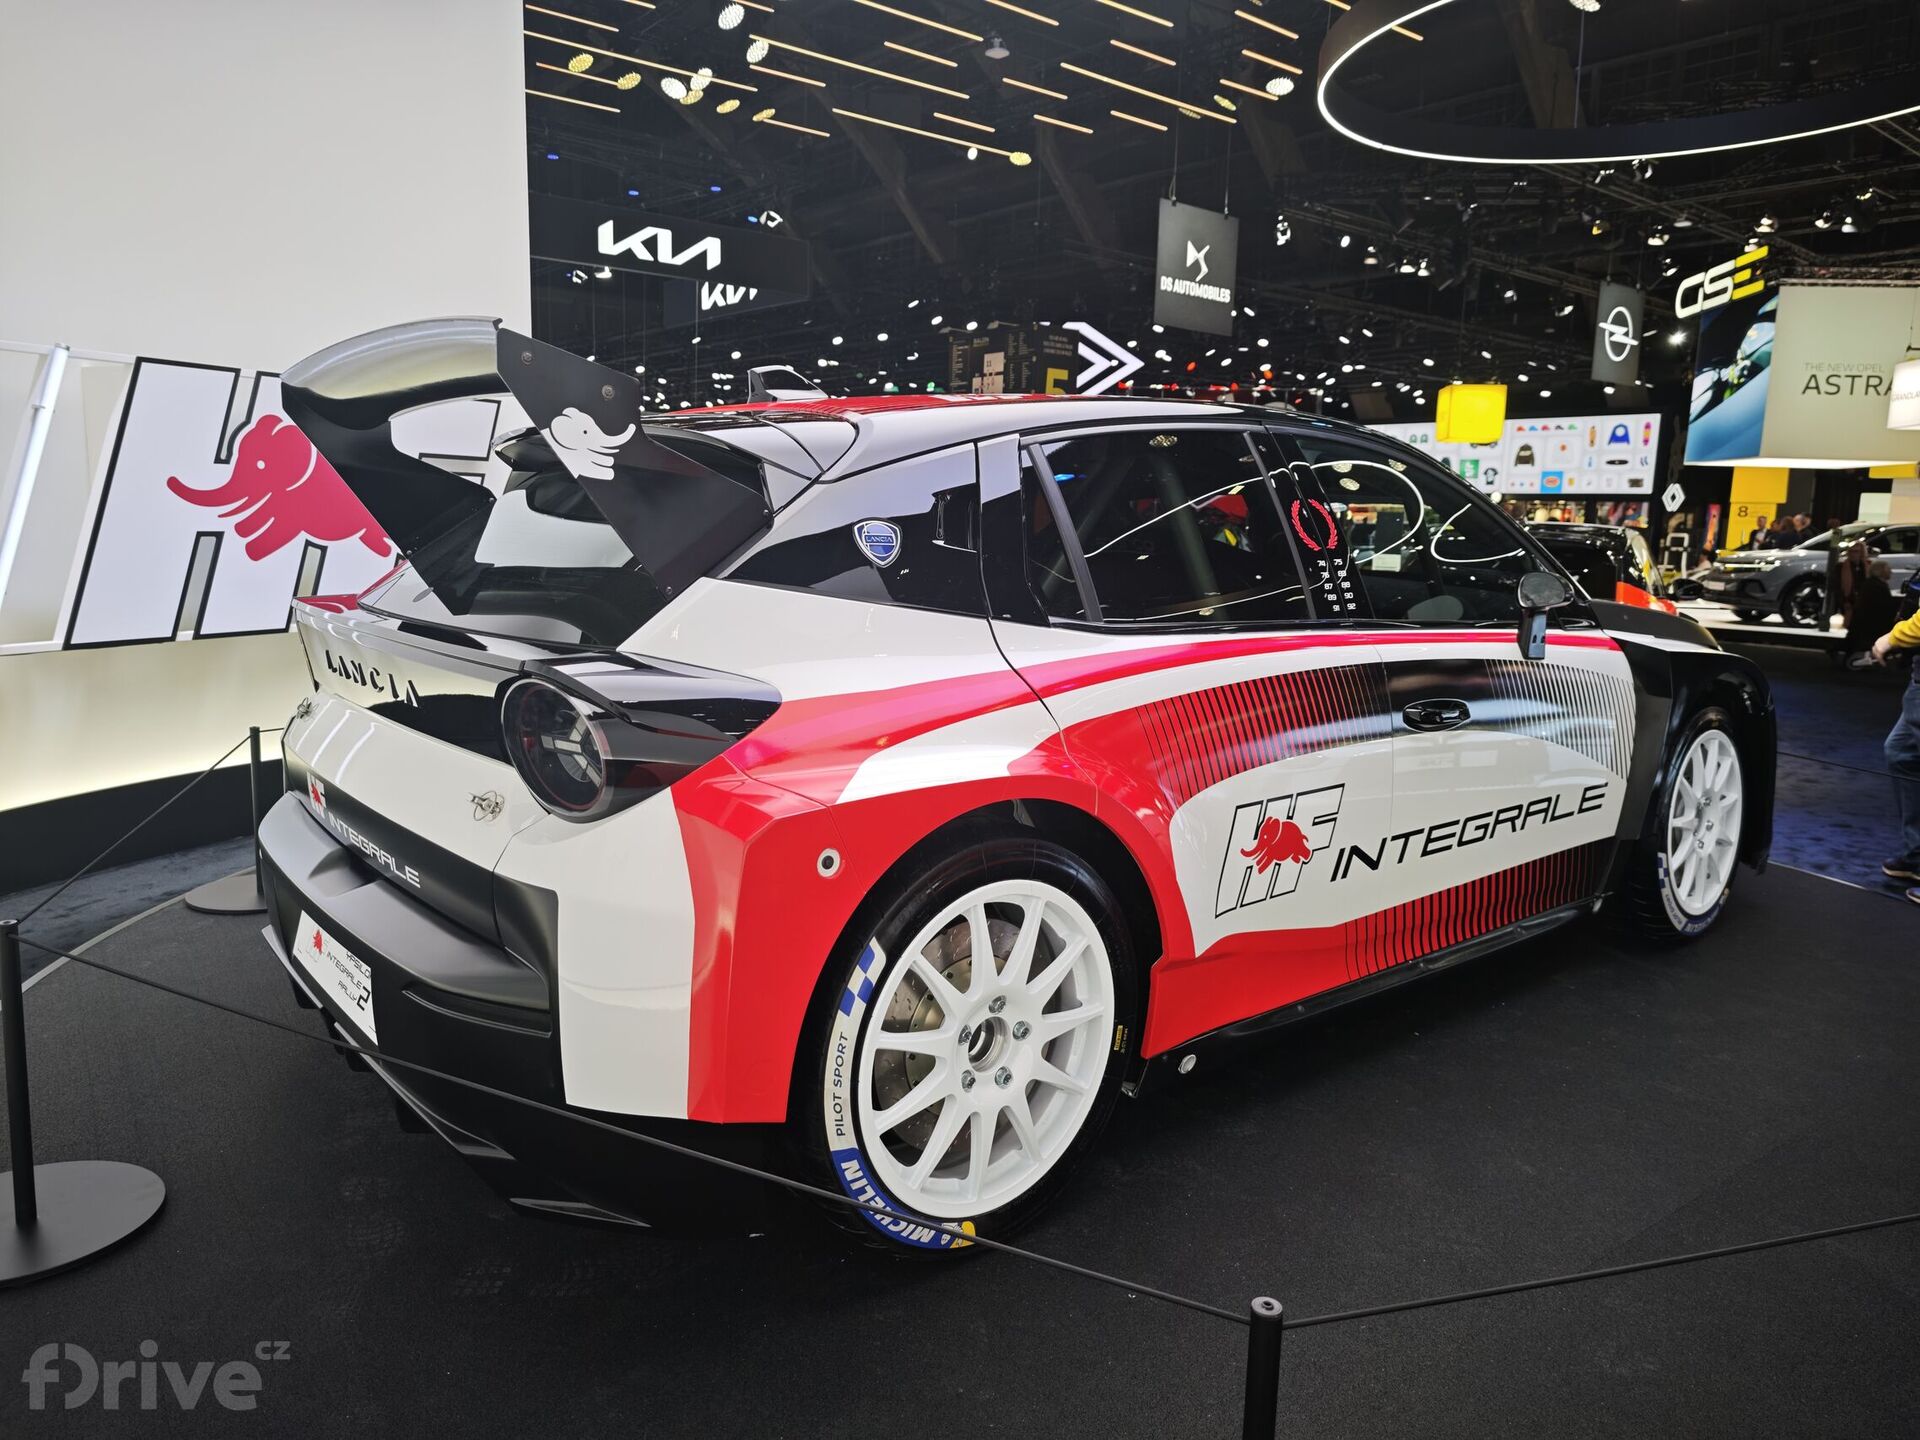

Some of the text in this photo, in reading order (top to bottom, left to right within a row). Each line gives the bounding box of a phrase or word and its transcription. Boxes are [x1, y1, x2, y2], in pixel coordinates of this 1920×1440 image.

[598, 219, 721, 271] KIA
[1160, 275, 1231, 303] DS AUTOMOBILES
[1675, 245, 1769, 319] GSE
[1805, 362, 1885, 373] THE NEW OPEL
[1738, 506, 1748, 517] 8
[325, 649, 421, 708] LANCIA
[328, 811, 421, 889] INTEGRALE
[1330, 782, 1609, 882] INTEGRALE
[326, 950, 363, 990] INTEGRALE
[345, 951, 371, 979] YPSILO
[337, 979, 371, 1012] RALLY 2
[832, 1031, 849, 1137] PILOT SPORT
